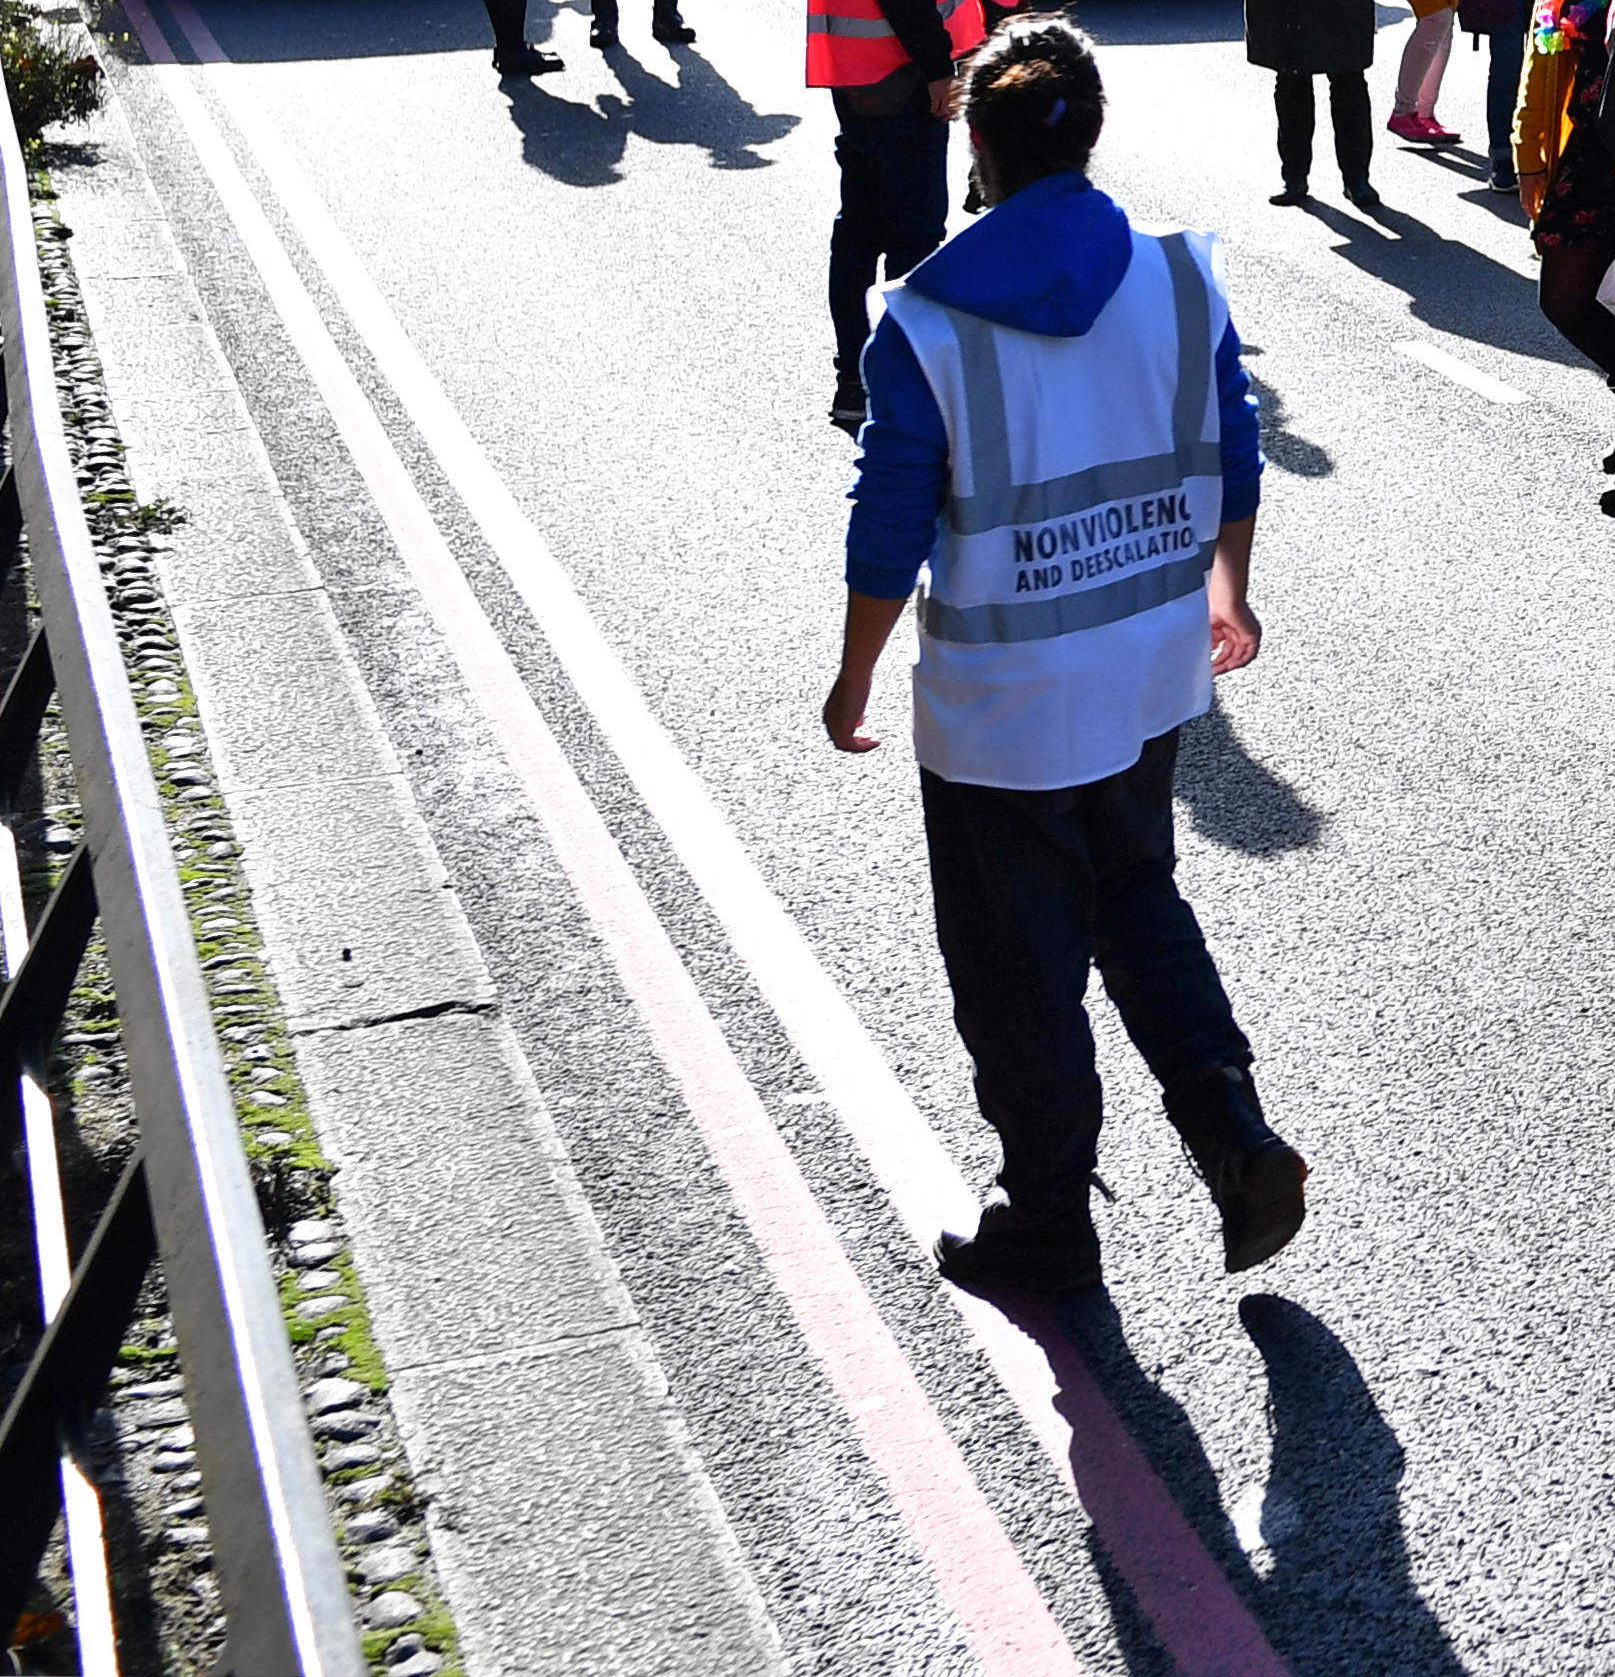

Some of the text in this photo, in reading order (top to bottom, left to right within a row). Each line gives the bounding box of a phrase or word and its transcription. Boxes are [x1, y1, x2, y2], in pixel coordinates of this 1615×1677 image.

[1013, 493, 1192, 563] NONVIOLENC
[1015, 526, 1193, 593] AND DEESCALATIO
